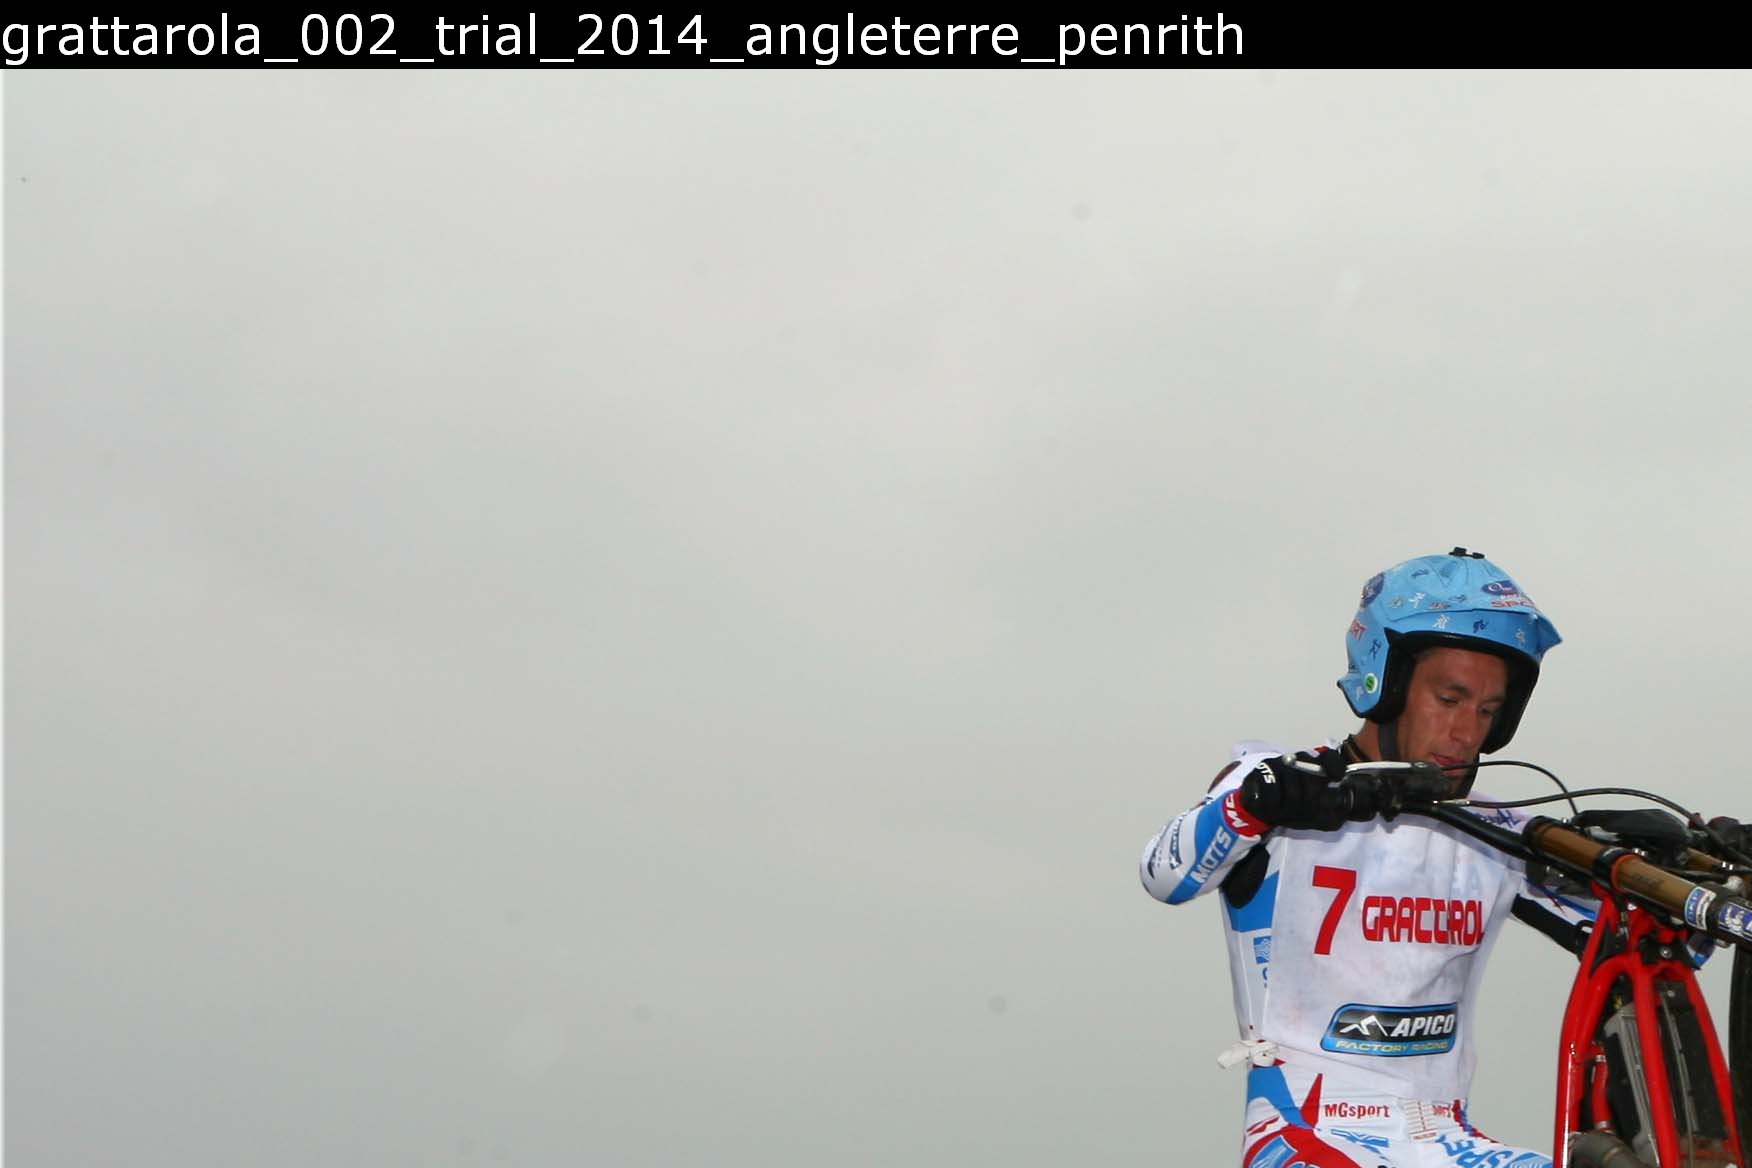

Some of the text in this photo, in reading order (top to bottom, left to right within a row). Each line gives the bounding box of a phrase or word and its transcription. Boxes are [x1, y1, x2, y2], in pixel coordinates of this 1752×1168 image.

[1189, 825, 1233, 885] MOTS
[1312, 865, 1357, 955] 7
[1390, 1014, 1456, 1038] APICO
[1324, 1102, 1391, 1119] MGsport
